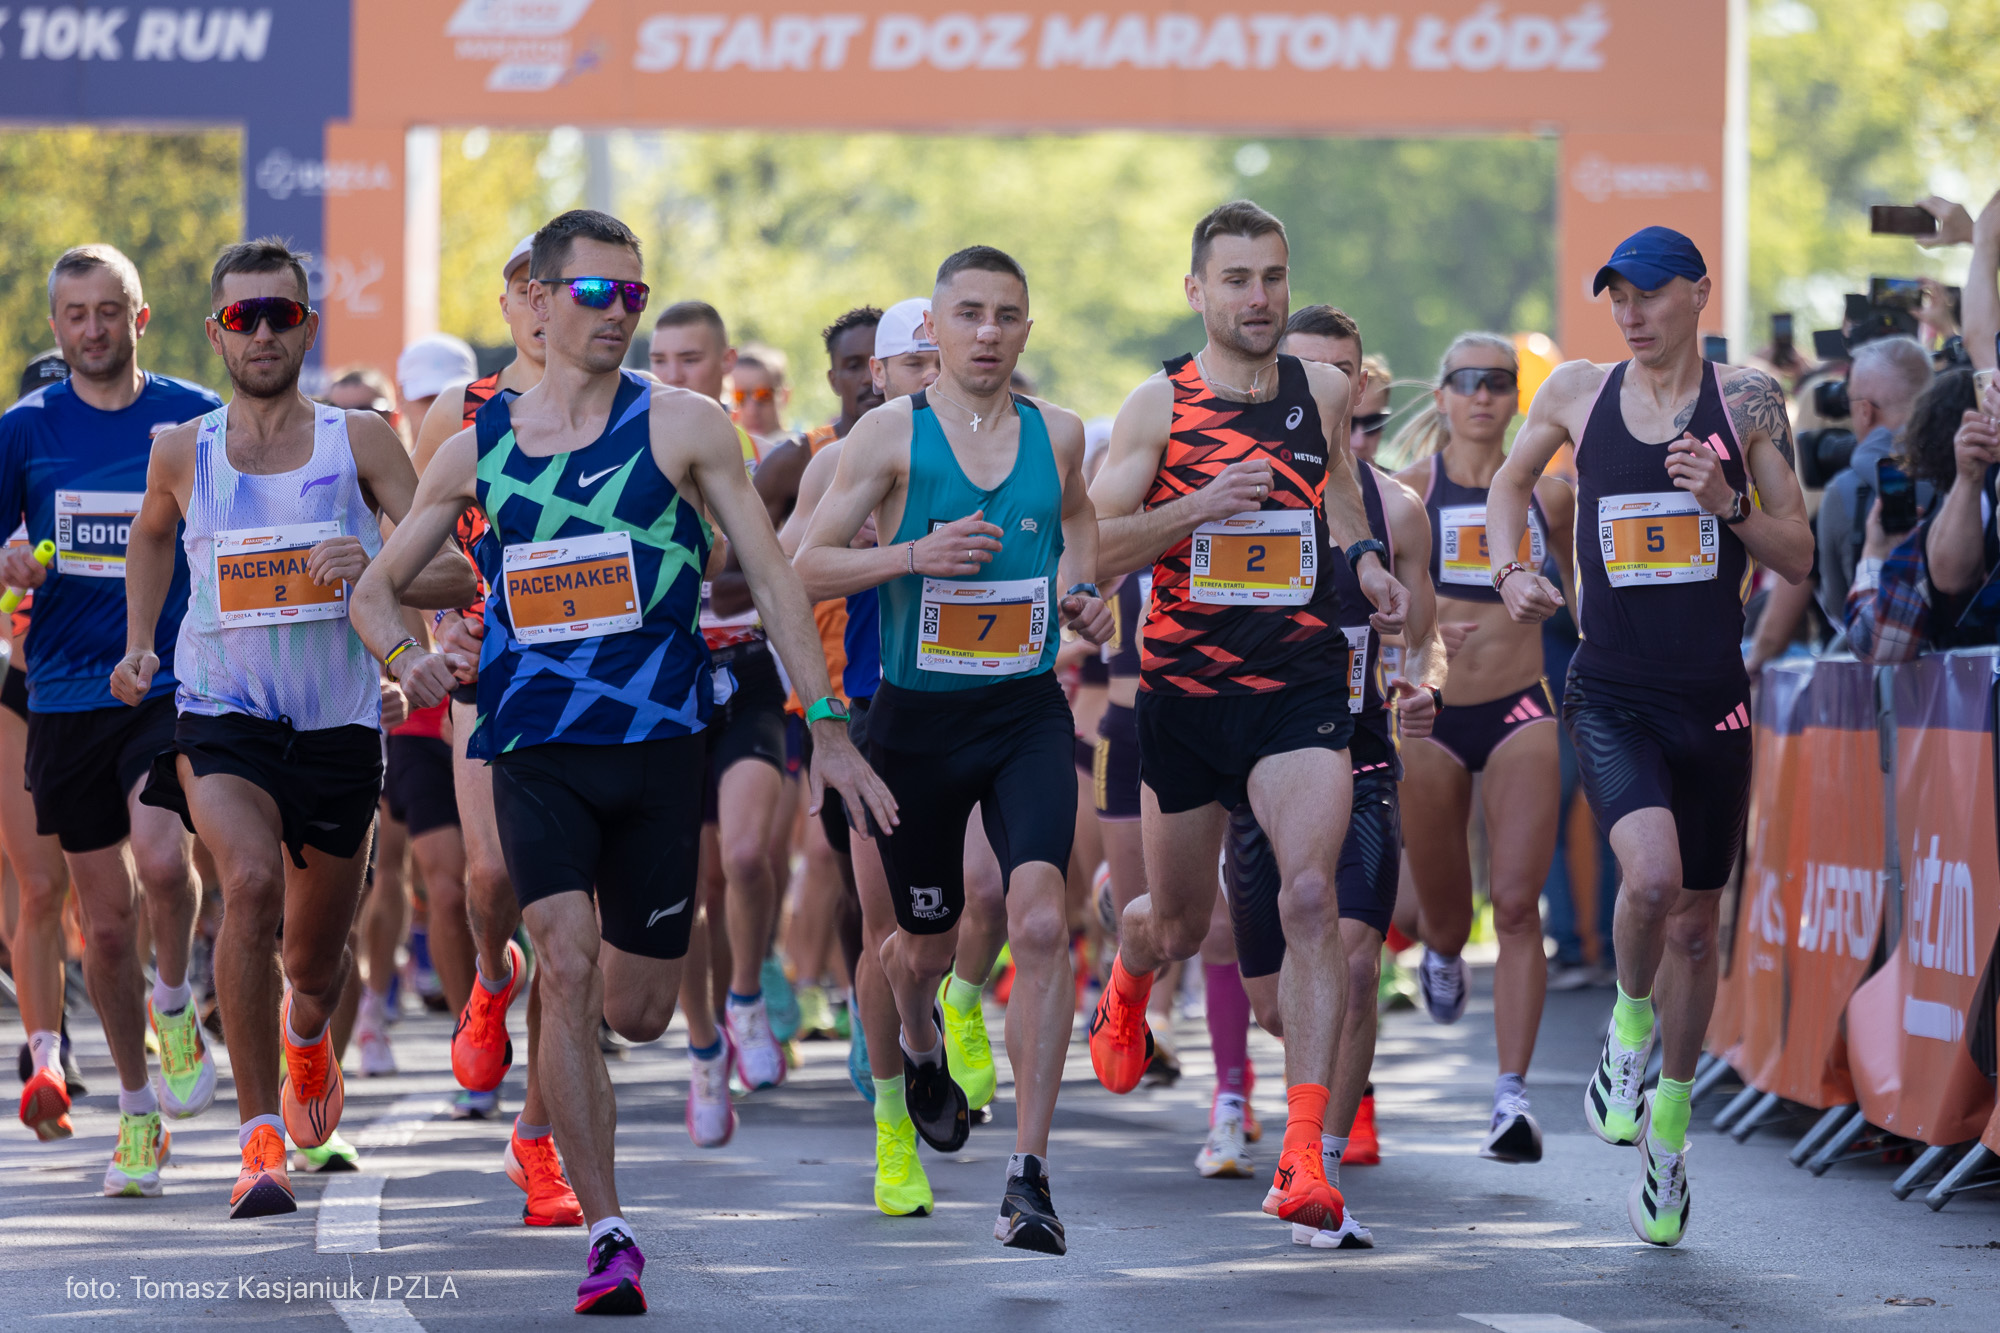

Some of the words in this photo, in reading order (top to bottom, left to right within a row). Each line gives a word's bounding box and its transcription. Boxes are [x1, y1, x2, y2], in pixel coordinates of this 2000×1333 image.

[19, 8, 128, 60] 10K
[133, 8, 272, 61] RUN
[633, 13, 866, 72] START
[871, 13, 1030, 71] DOZ
[1038, 13, 1398, 71] MARATON
[1409, 2, 1610, 72] ŁÓDŹ
[1294, 452, 1322, 465] NETBOX
[1646, 526, 1665, 552] 5
[220, 557, 312, 581] PACEMAK
[1246, 545, 1266, 572] 2
[274, 585, 287, 602] 2
[509, 565, 629, 597] PACEMAKER
[563, 600, 576, 617] 3
[977, 614, 997, 641] 7
[928, 648, 950, 656] STREFA
[952, 650, 975, 658] STARTU
[913, 906, 950, 918] DUCLA
